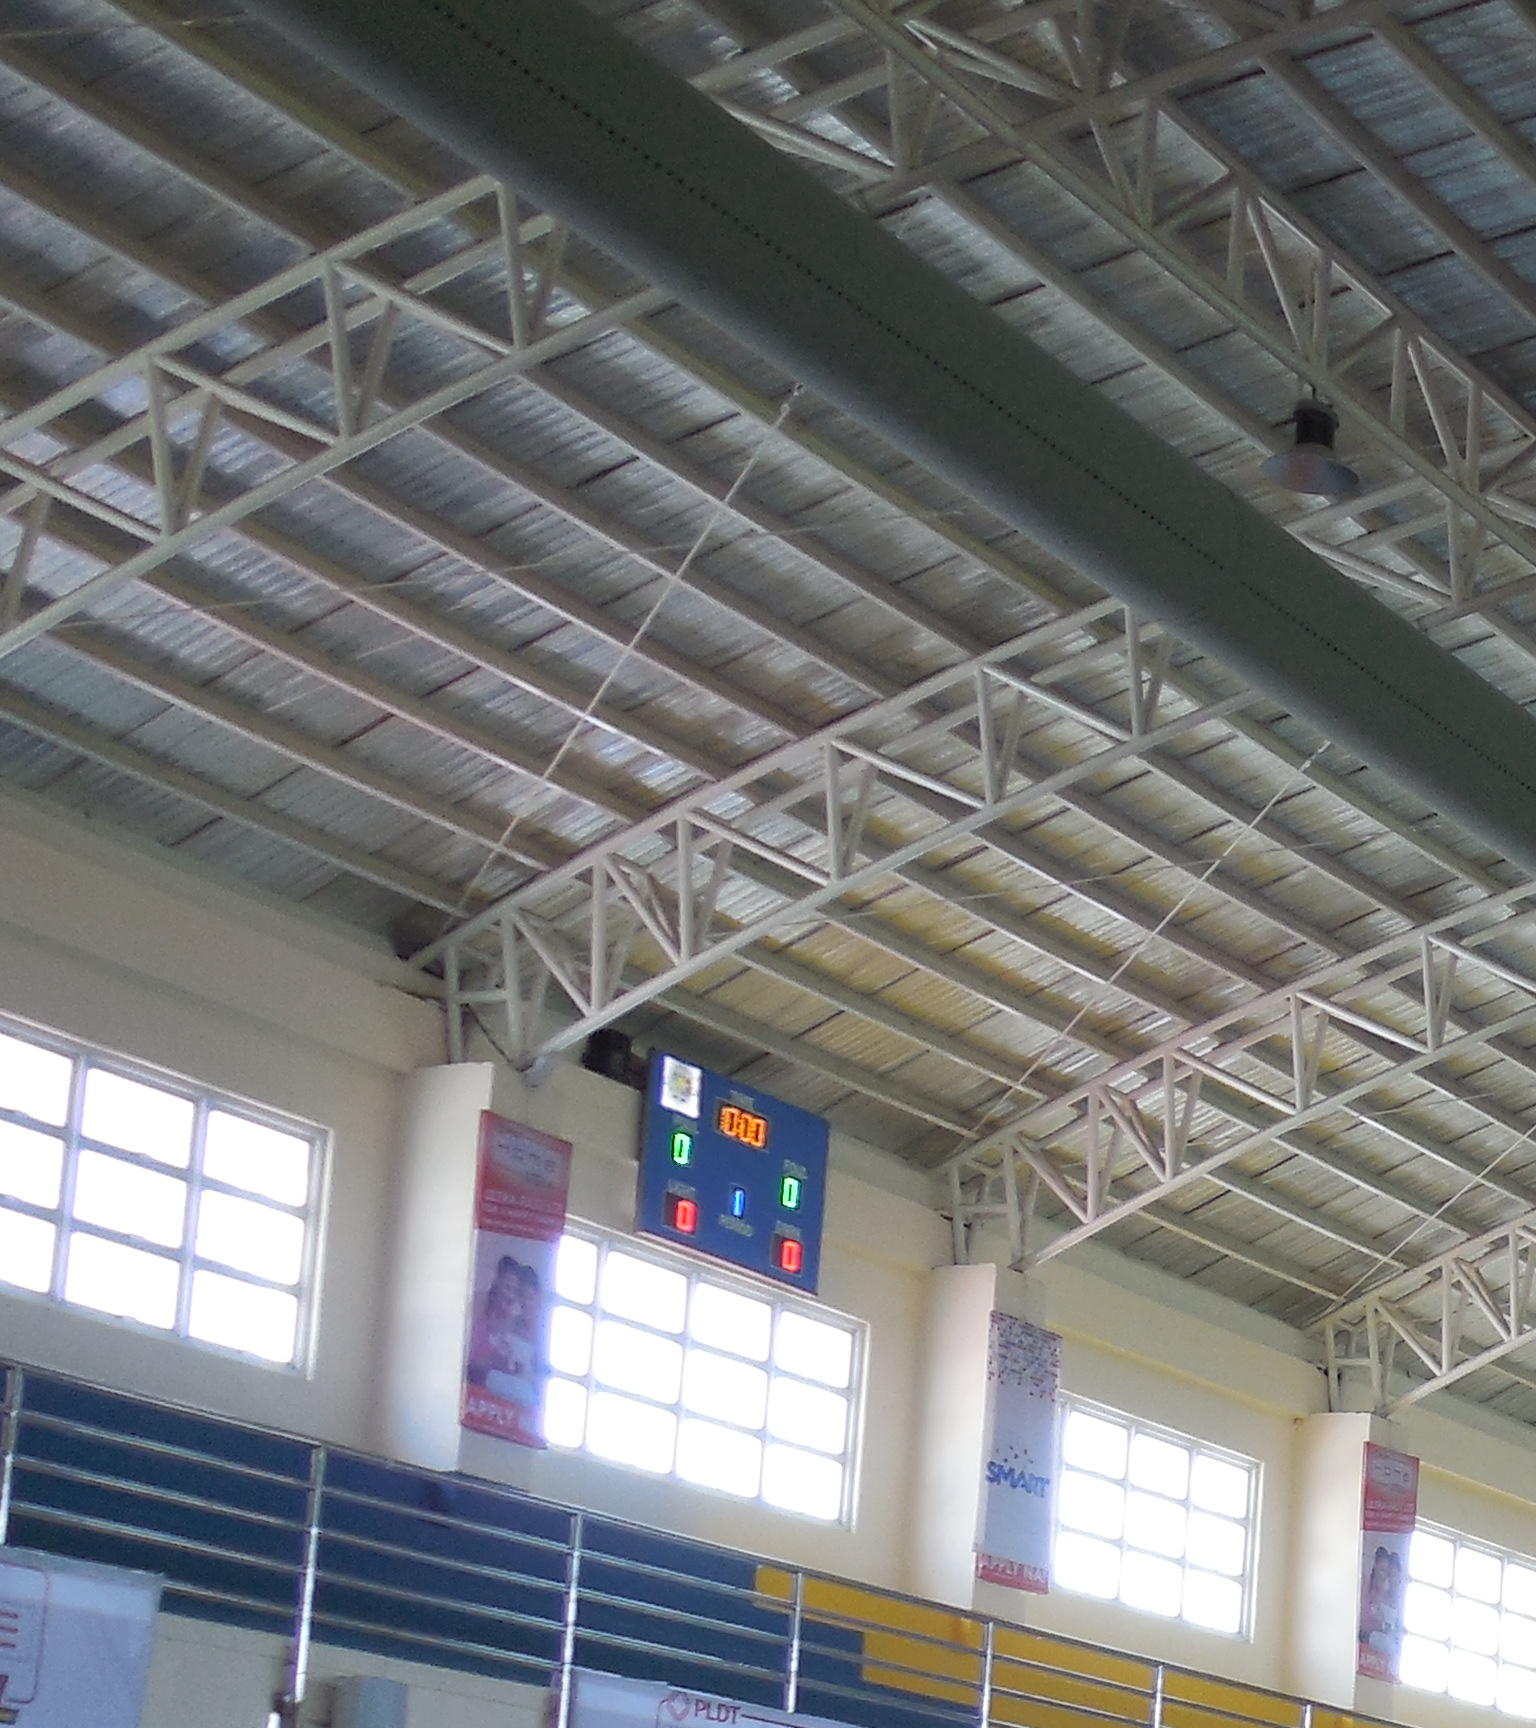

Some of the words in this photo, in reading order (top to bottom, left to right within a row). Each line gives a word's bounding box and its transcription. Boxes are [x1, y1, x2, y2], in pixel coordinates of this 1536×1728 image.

[673, 1132, 692, 1165] 0
[781, 1176, 801, 1210] 0
[694, 1699, 741, 1725] PLDT
